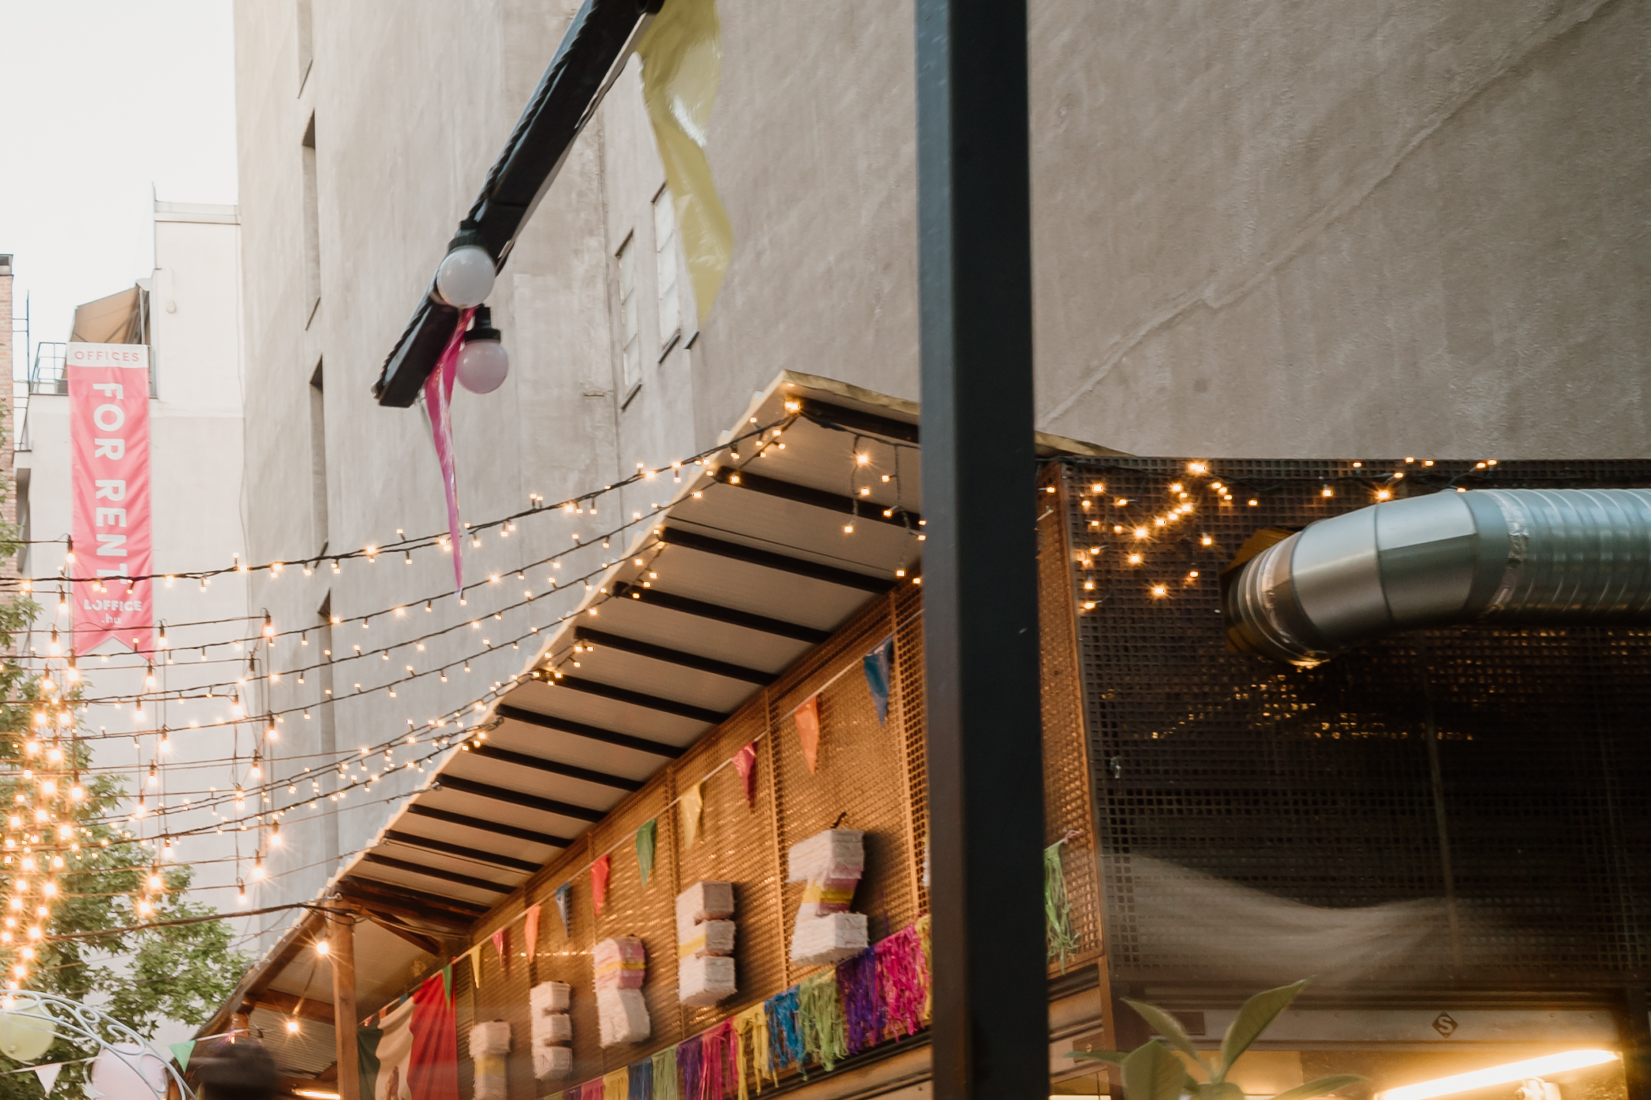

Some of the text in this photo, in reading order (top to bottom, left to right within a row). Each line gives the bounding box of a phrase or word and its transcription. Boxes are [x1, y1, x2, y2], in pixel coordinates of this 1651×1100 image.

[74, 351, 139, 362] OFFICES
[92, 383, 128, 586] FOR RENT
[83, 599, 142, 612] LOFFICE
